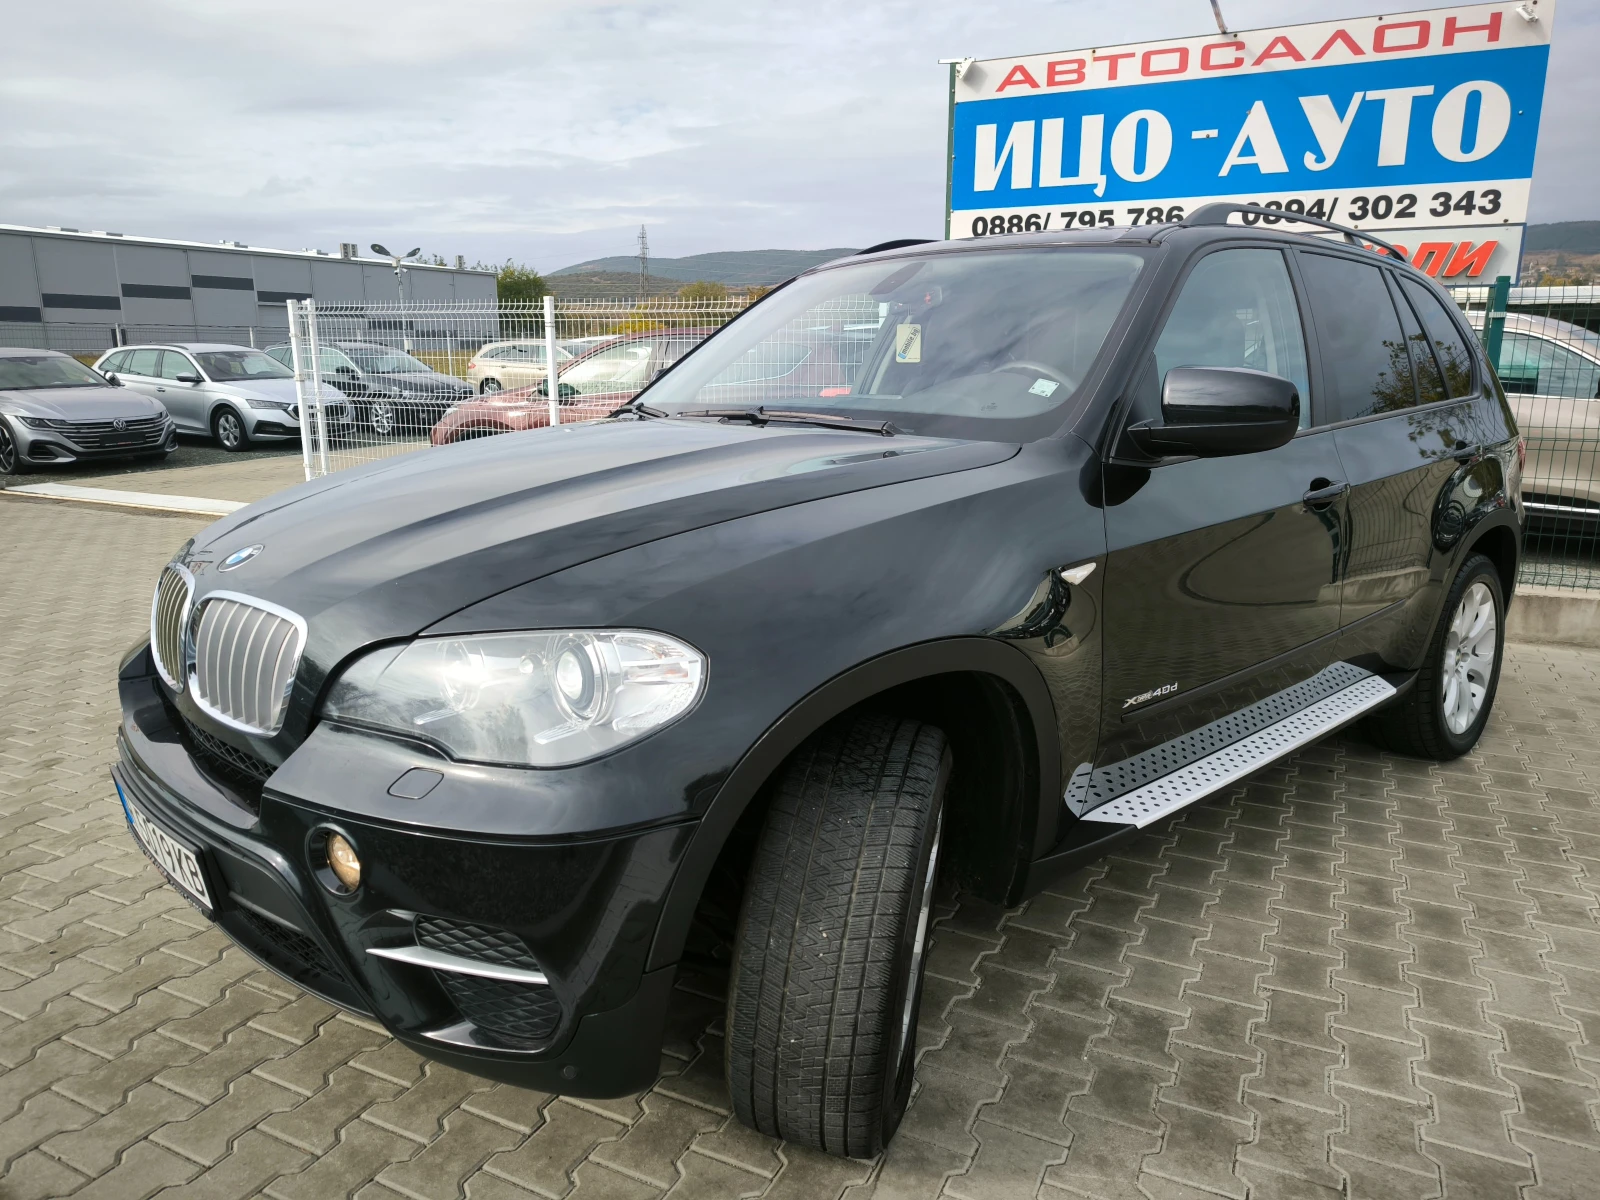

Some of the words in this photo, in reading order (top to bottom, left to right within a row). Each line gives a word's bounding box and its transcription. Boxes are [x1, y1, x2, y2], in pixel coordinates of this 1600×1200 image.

[995, 12, 1504, 93] АВТОСАЛОН
[973, 109, 1174, 198] ИЦО
[971, 212, 1052, 237] 0886/
[1060, 209, 1115, 229] 795
[1127, 205, 1185, 226] 786
[1348, 193, 1418, 221] 302
[1429, 189, 1503, 218] 343
